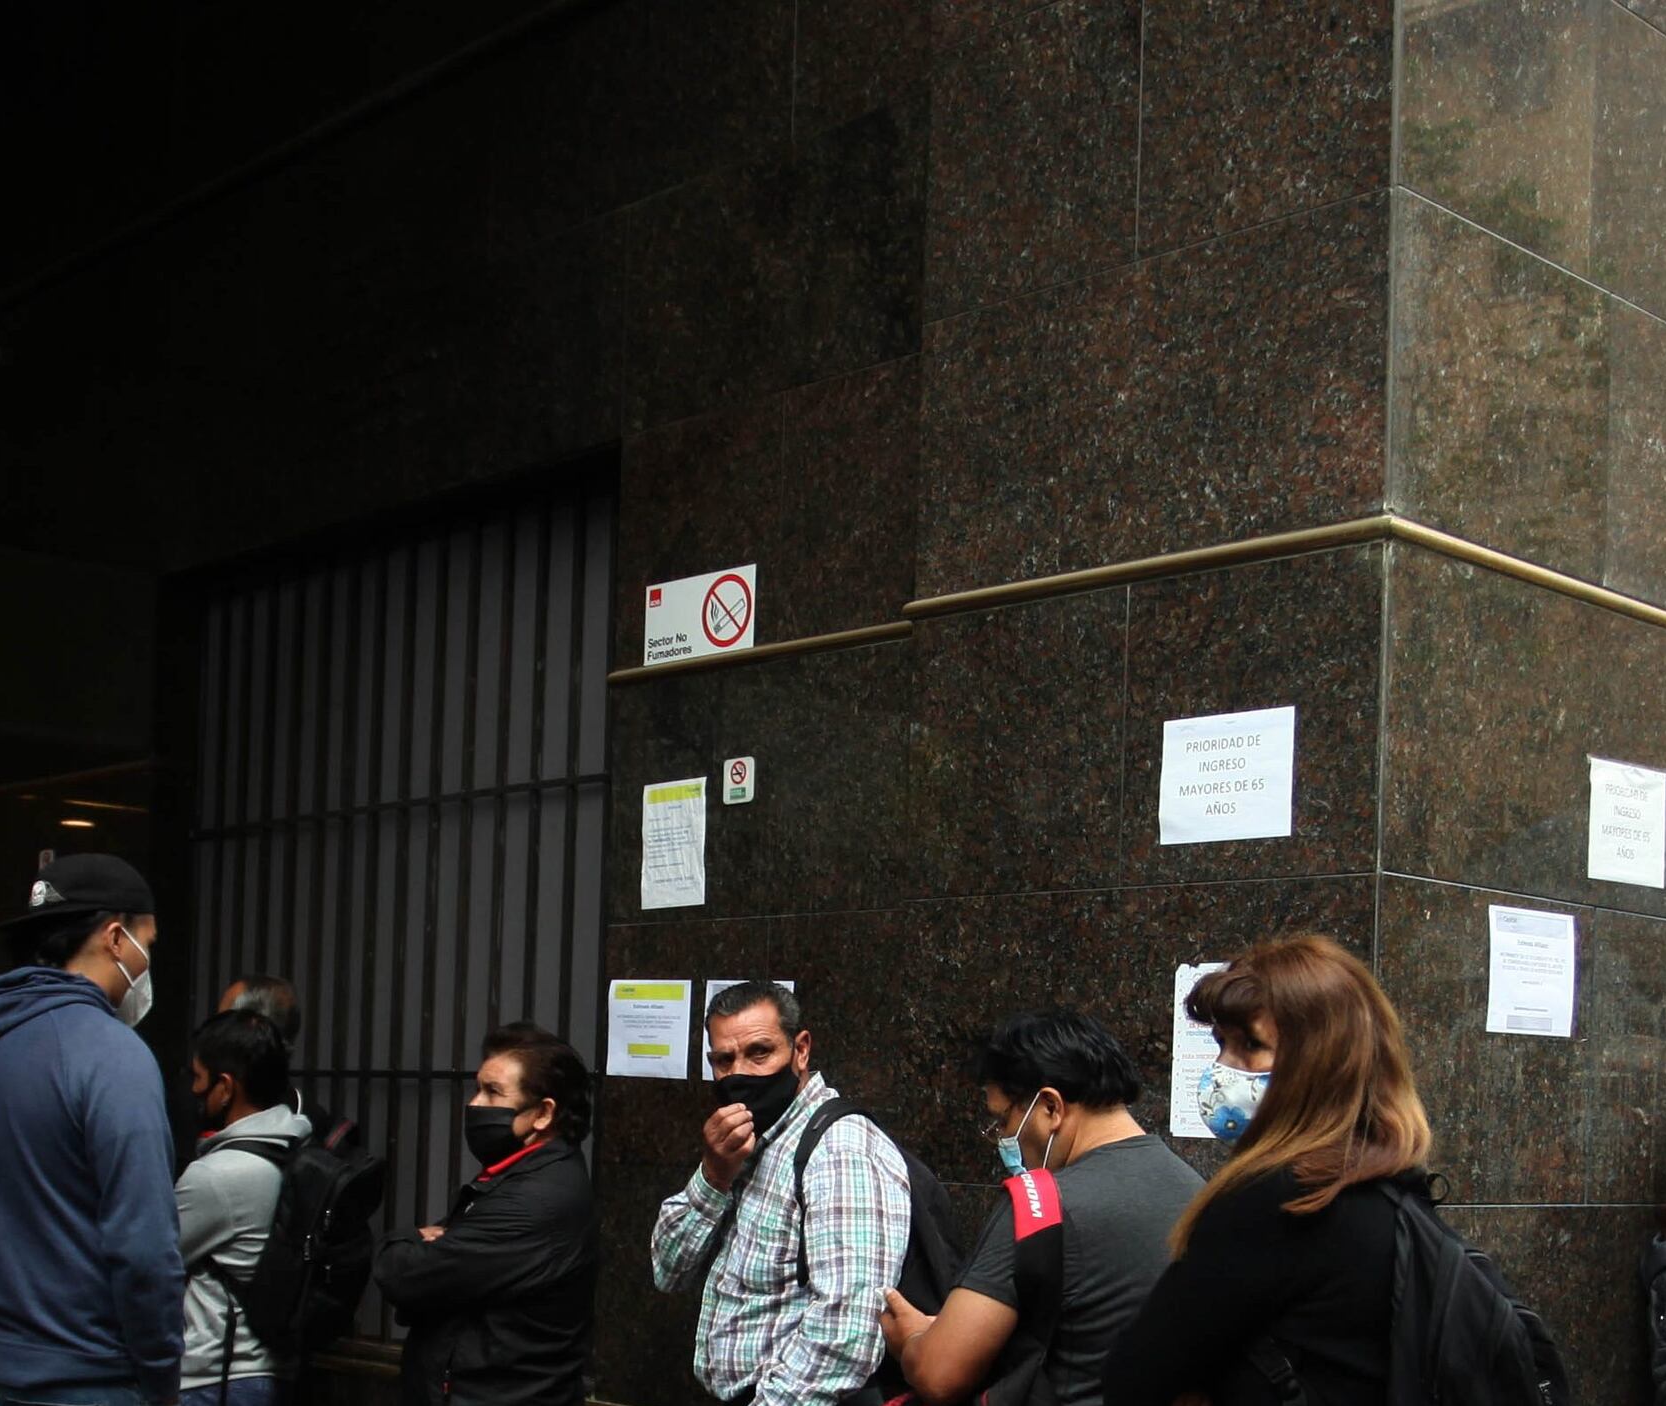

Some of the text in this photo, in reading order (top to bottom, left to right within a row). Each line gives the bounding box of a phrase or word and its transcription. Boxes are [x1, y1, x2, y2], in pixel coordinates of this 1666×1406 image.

[647, 633, 687, 649] Sector No
[647, 646, 692, 661] Fumadores
[1185, 734, 1262, 753] PRIORIDAD DE
[1198, 757, 1247, 773] INGRESO
[1178, 778, 1265, 797] MAYORES DE 65
[1204, 801, 1237, 816] AÑOS
